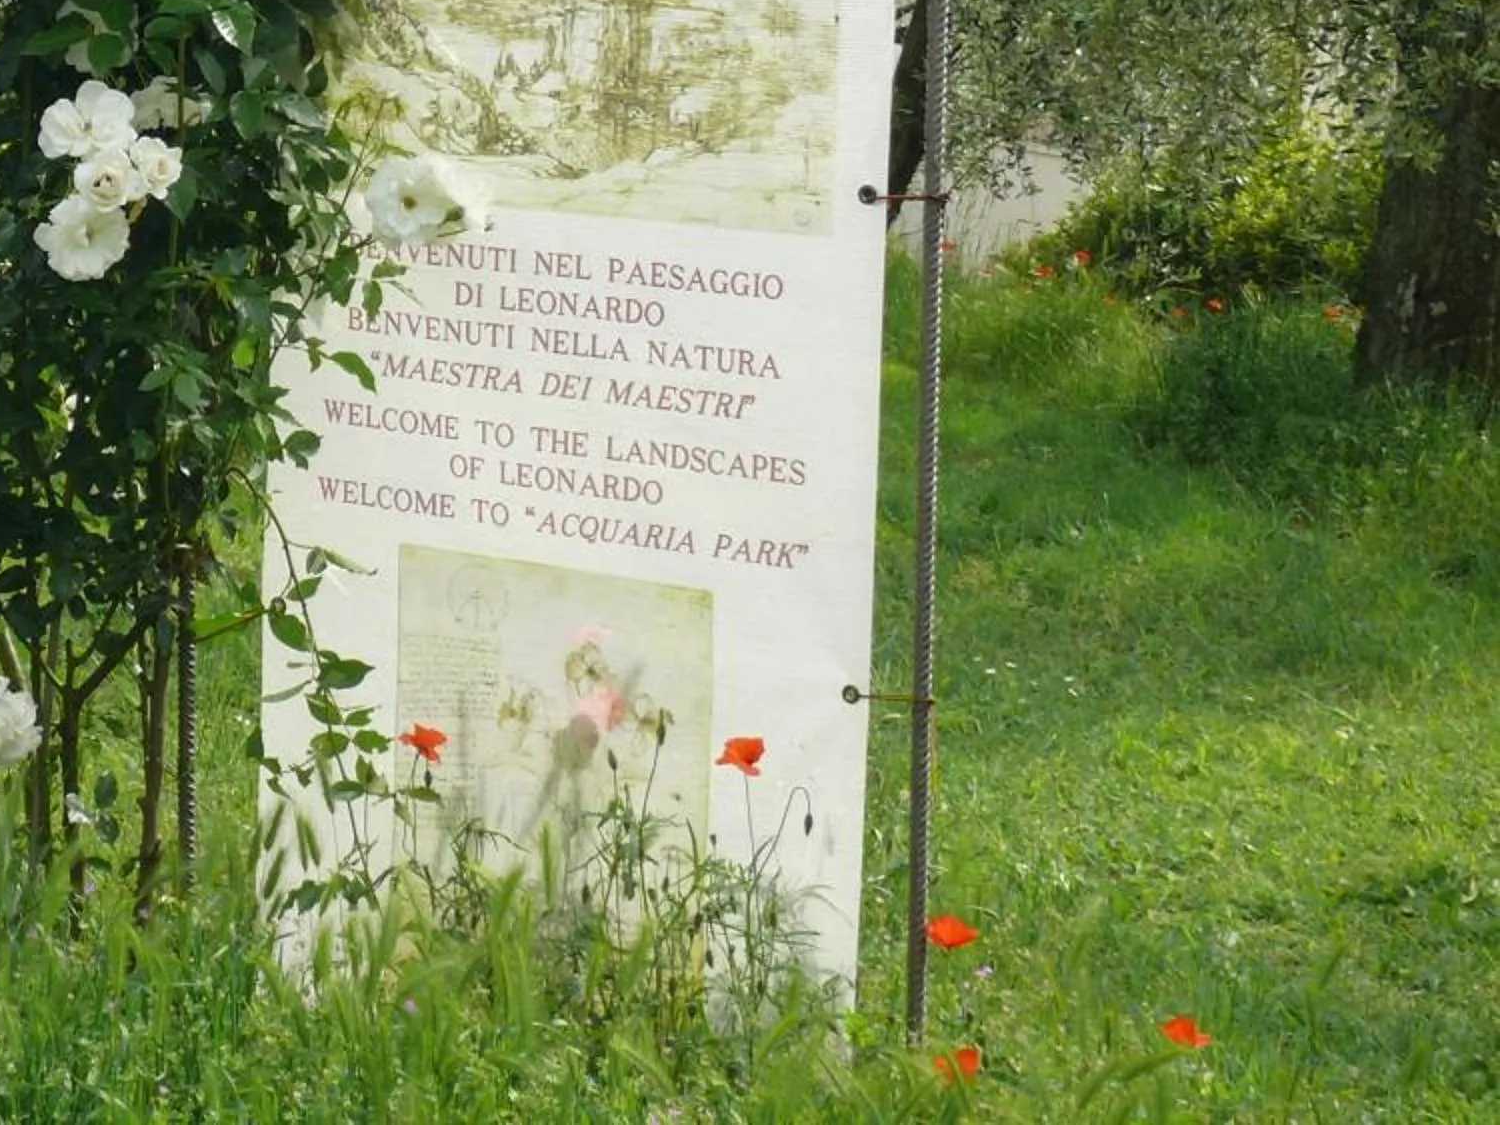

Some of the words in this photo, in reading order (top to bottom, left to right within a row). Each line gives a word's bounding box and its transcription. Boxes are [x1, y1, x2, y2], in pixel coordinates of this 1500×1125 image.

[534, 252, 591, 279] NEL
[608, 258, 784, 299] PAESAGGIO
[455, 281, 483, 308] DI
[500, 285, 665, 327] LEONARDO
[531, 327, 628, 361] NELLA
[647, 340, 781, 379] NATURA
[540, 372, 592, 402] DEI
[323, 398, 460, 440] WELCOME
[474, 419, 515, 448] TO
[530, 426, 588, 458] THE
[606, 436, 806, 485] LANDSCAPES
[317, 476, 456, 519] WELCOME
[471, 497, 510, 526] TO
[449, 453, 483, 481] OF
[499, 460, 663, 504] LEONARDO
